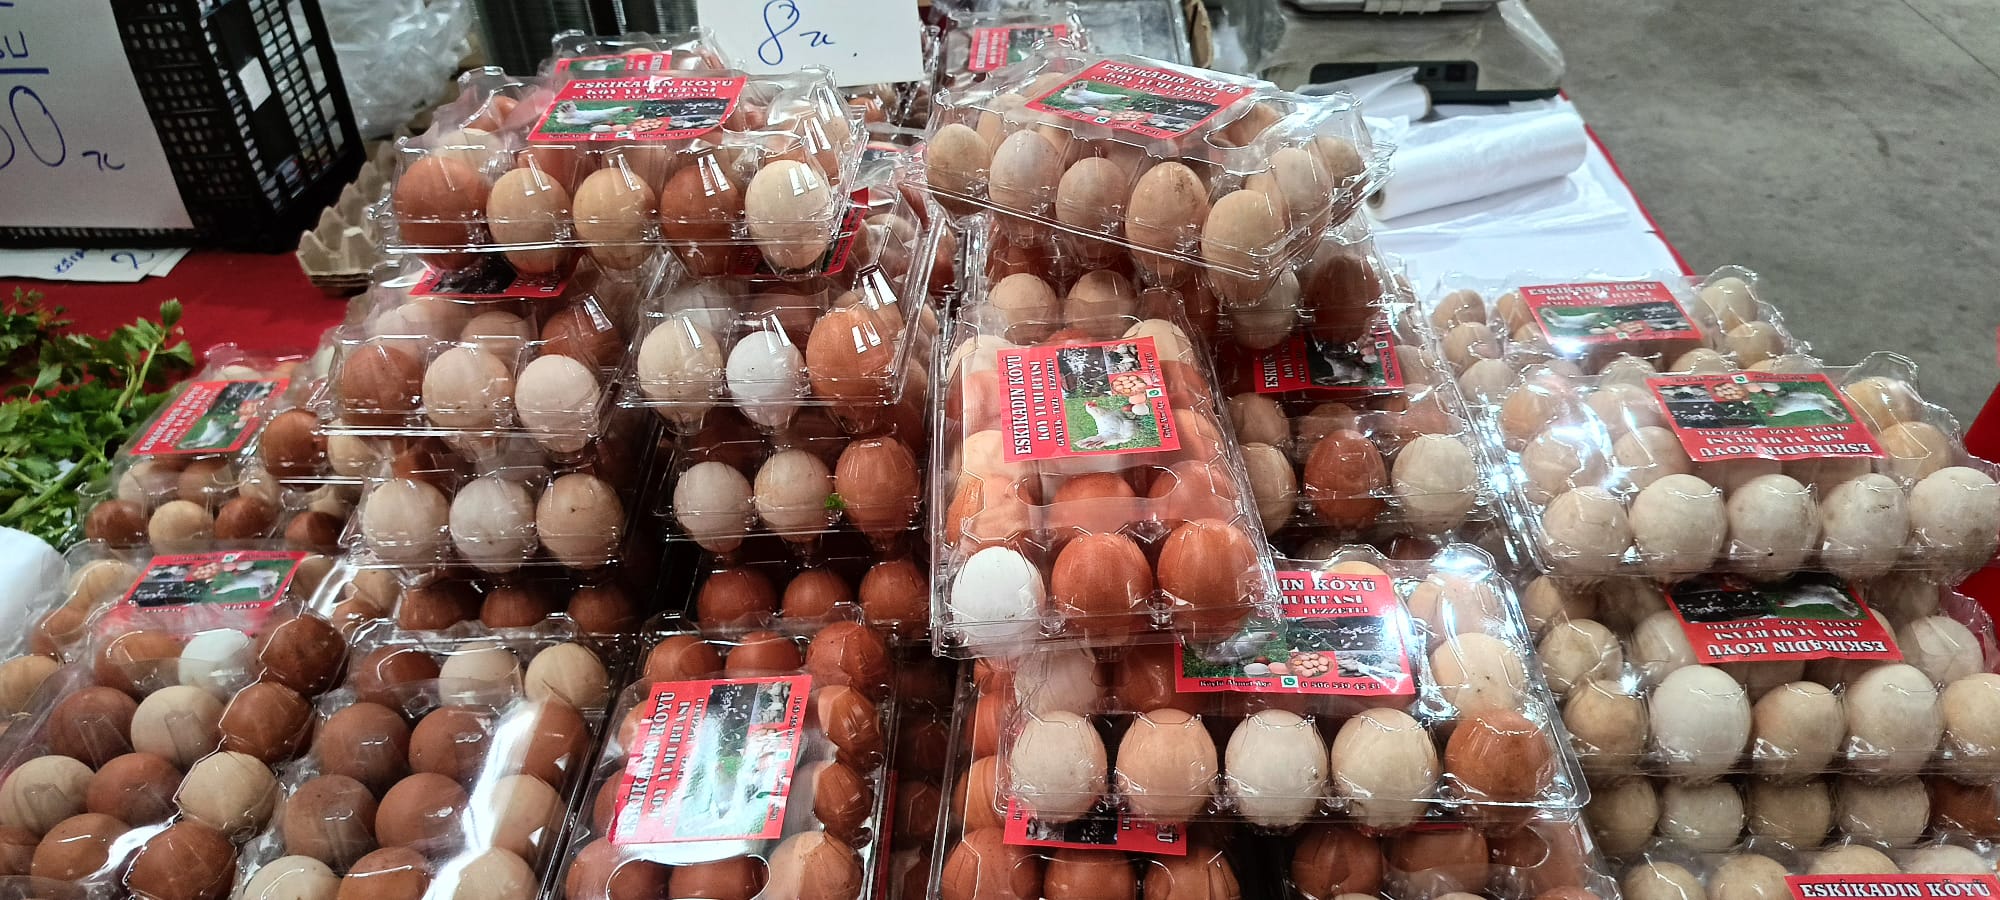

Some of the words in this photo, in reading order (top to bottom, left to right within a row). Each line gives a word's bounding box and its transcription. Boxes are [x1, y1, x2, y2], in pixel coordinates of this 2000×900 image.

[758, 0, 800, 66] 8
[1003, 355, 1024, 386] KÖYÜ
[1311, 575, 1377, 592] KÖYÜ
[1706, 642, 1769, 659] KÖYÜ
[649, 691, 676, 736] KÖYÜ
[1799, 879, 1922, 898] ESKİKADIN
[1926, 878, 1991, 897] KÖYÜ
